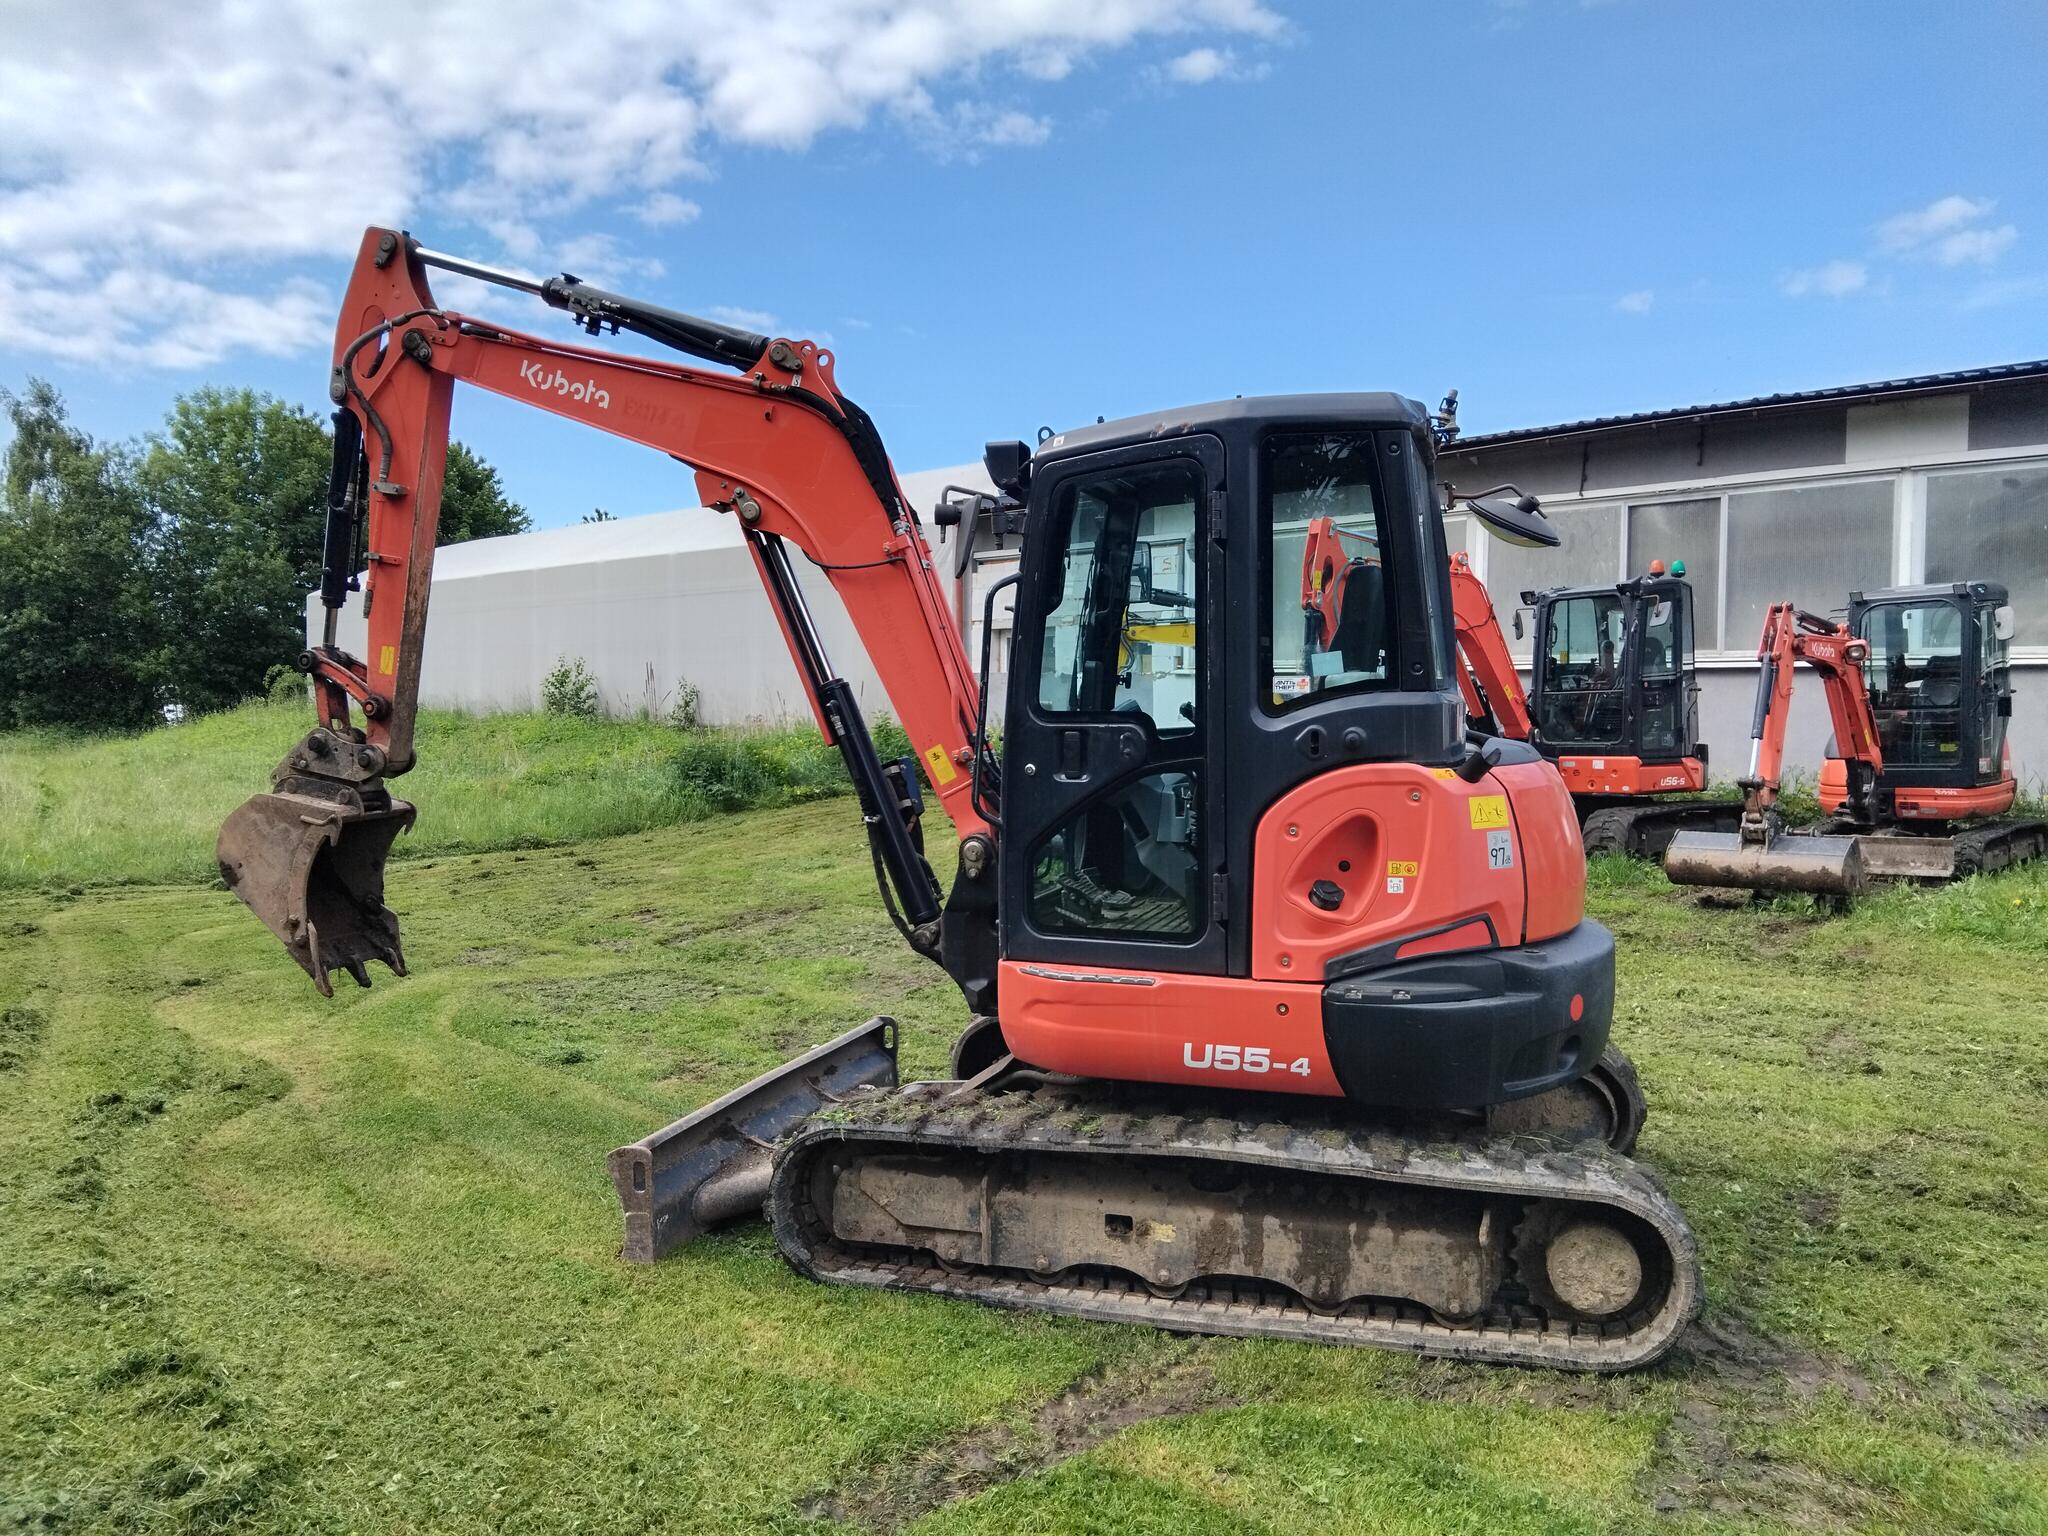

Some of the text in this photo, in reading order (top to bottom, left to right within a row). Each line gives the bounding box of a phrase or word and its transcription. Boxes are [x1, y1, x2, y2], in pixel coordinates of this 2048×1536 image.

[519, 359, 610, 409] Kubota
[1811, 641, 1835, 657] Kubota
[1490, 847, 1506, 866] 97
[1183, 1042, 1311, 1077] U55-4
